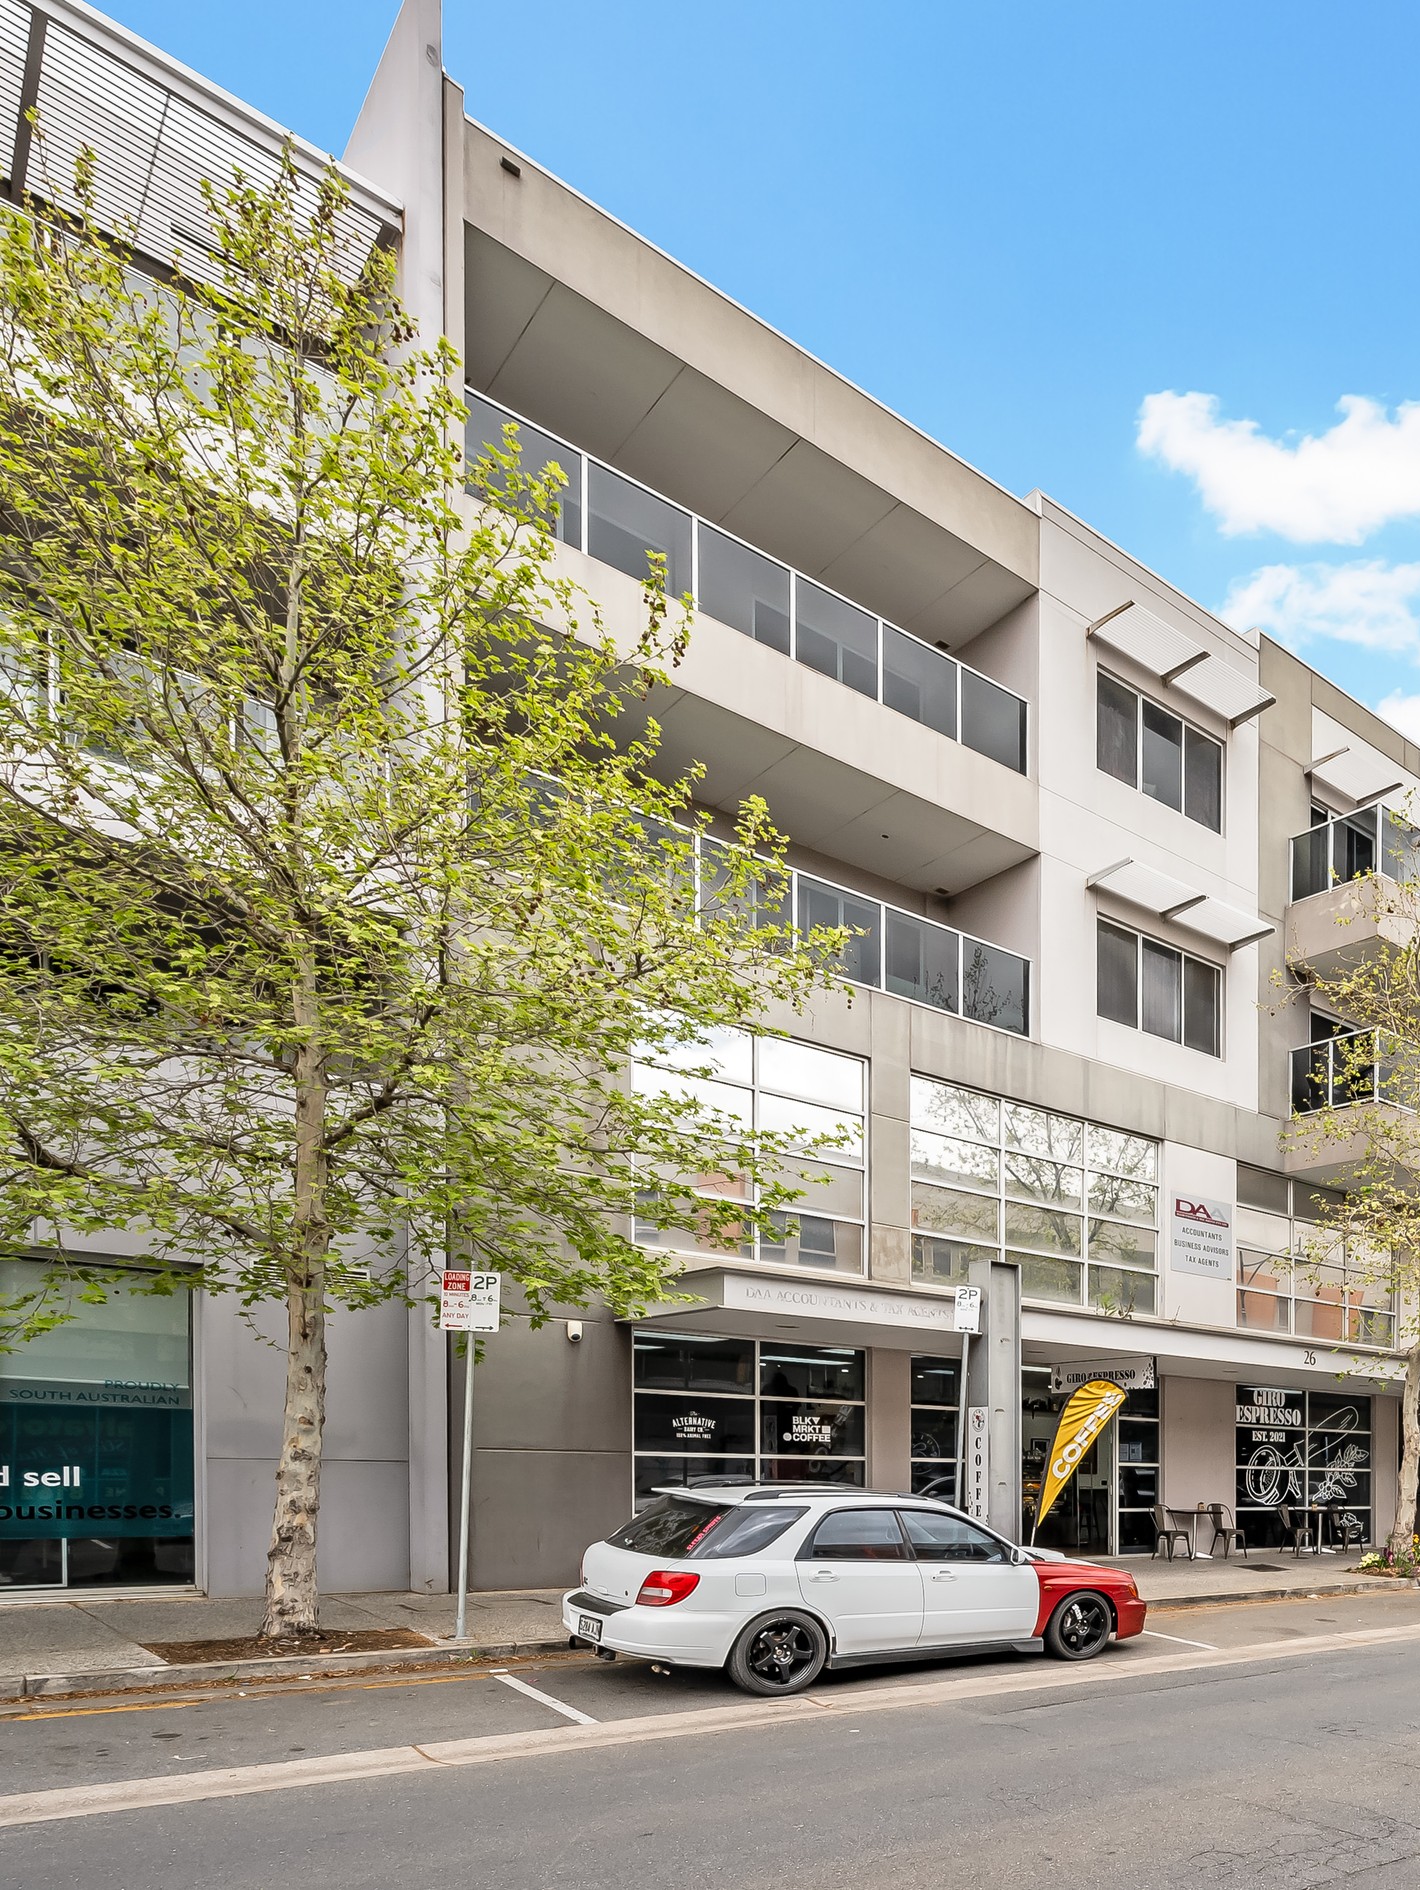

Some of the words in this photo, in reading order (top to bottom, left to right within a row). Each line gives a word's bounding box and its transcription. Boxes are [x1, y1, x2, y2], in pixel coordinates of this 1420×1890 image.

[1181, 1226, 1223, 1241] ACCOUNTANTS
[1173, 1239, 1202, 1251] BUSINESS
[1202, 1245, 1229, 1257] ADVISORS
[1185, 1254, 1197, 1263] TAX
[1197, 1257, 1220, 1268] AGENTS
[444, 1272, 470, 1281] LOADING
[473, 1275, 498, 1290] 2P
[446, 1282, 467, 1290] ZONE
[745, 1286, 772, 1300] DAA
[958, 1288, 979, 1300] 2P
[1303, 1350, 1317, 1366] 26
[1066, 1372, 1087, 1384] GIRO
[1092, 1369, 1136, 1380] ESPRESSO
[104, 1379, 181, 1392] PROUDLY
[9, 1389, 72, 1401] SOUTH
[76, 1391, 180, 1405] AUSTRALIAN
[1253, 1389, 1286, 1408] GIRO
[792, 1415, 812, 1425] BLK
[1235, 1404, 1302, 1427] ESPRESSO
[672, 1416, 717, 1430] ALTERNATIVE
[792, 1424, 821, 1434] MRKT
[792, 1433, 831, 1442] COFFEE
[1052, 1391, 1124, 1479] COFFEE
[1251, 1430, 1268, 1442] EST.
[1269, 1431, 1286, 1443] 2021
[23, 1465, 81, 1487] sell
[974, 1436, 983, 1518] COFFE
